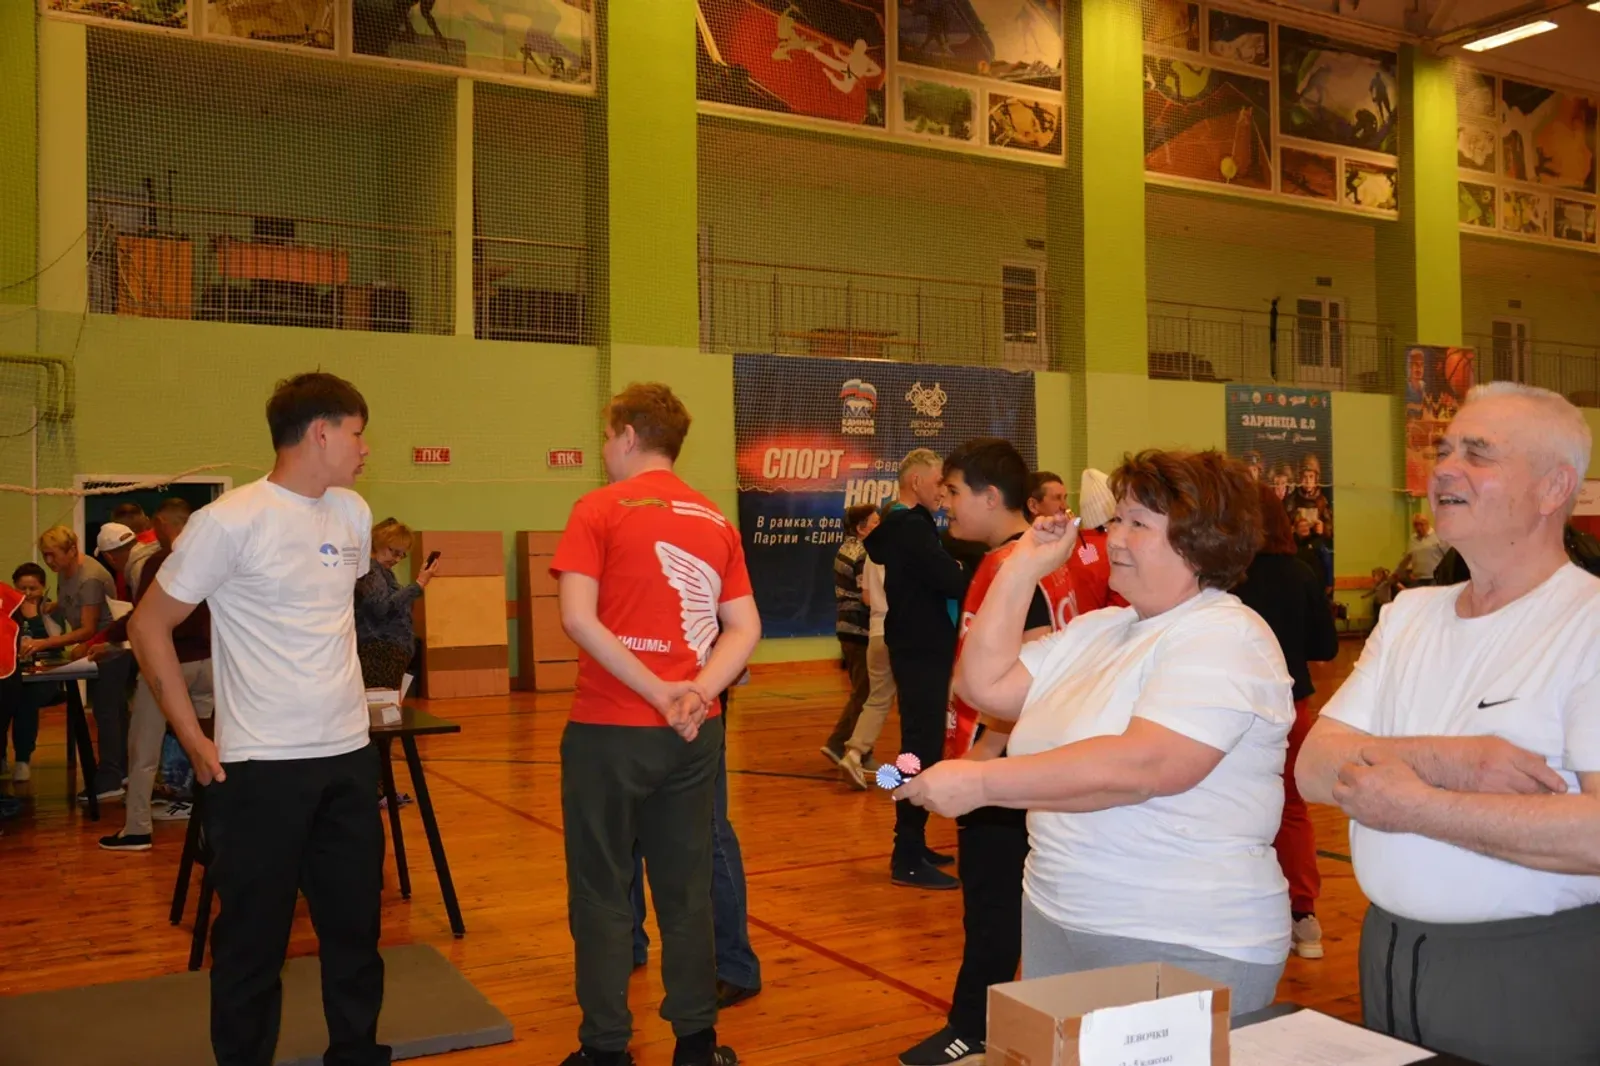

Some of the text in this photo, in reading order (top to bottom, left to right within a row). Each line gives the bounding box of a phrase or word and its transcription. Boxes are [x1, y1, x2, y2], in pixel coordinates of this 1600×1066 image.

[842, 418, 874, 427] ЕДИНАЯ
[1241, 414, 1298, 430] ЗАРНИЦА
[842, 426, 874, 435] РОССИЯ
[914, 429, 939, 437] СПОРТ
[422, 449, 442, 461] ПК
[557, 452, 576, 464] ПК
[762, 447, 845, 479] СПОРТ
[756, 515, 765, 528] В
[769, 516, 814, 530] рамках
[754, 531, 799, 546] Партии
[1123, 1028, 1169, 1046] ДЕВОЧКИ
